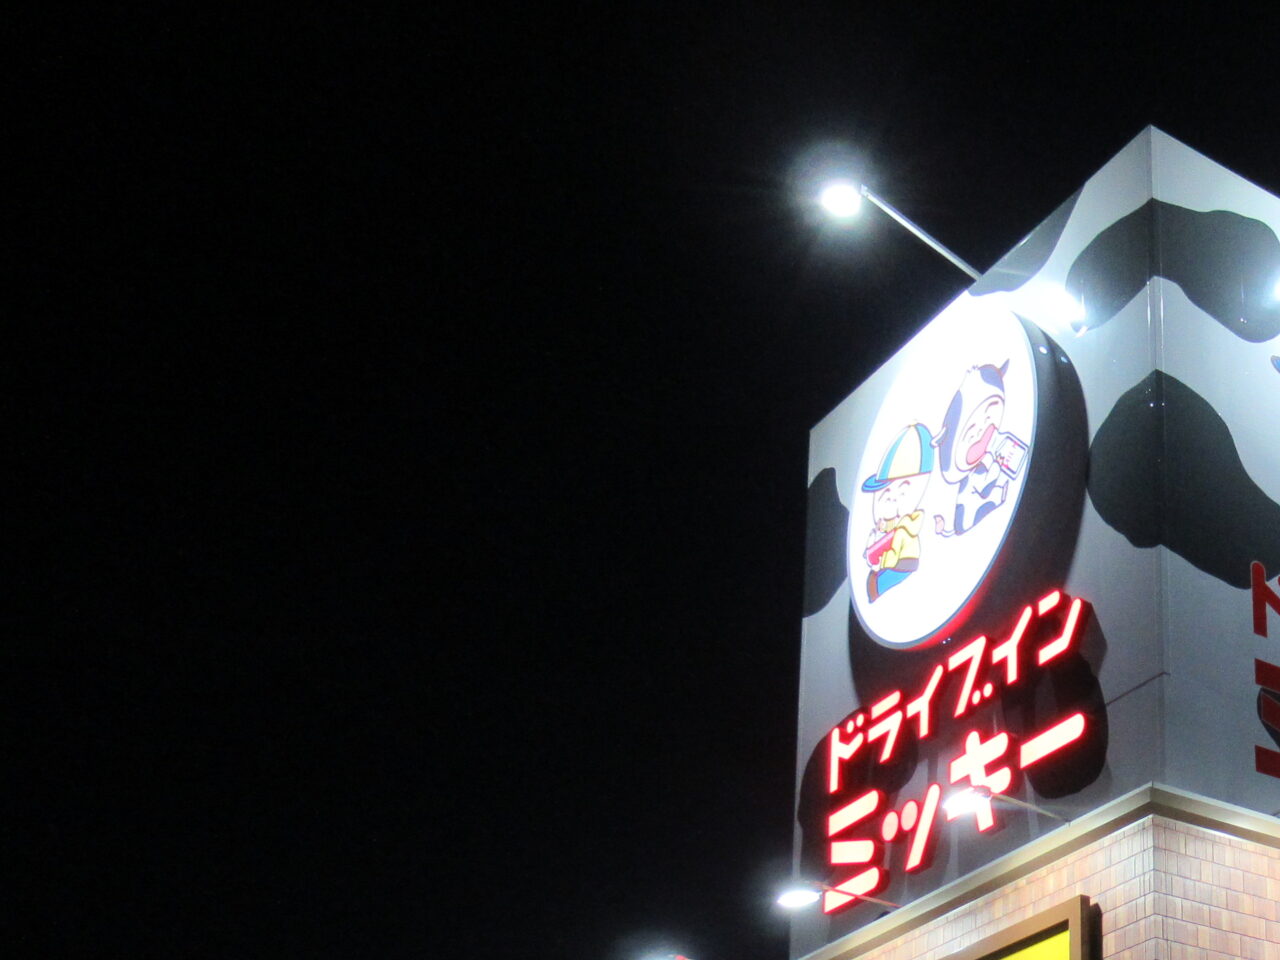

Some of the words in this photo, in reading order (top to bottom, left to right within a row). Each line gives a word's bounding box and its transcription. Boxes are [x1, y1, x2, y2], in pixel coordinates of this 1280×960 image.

[828, 589, 1083, 794] ドライブイン
[823, 712, 1086, 914] ミッキー
